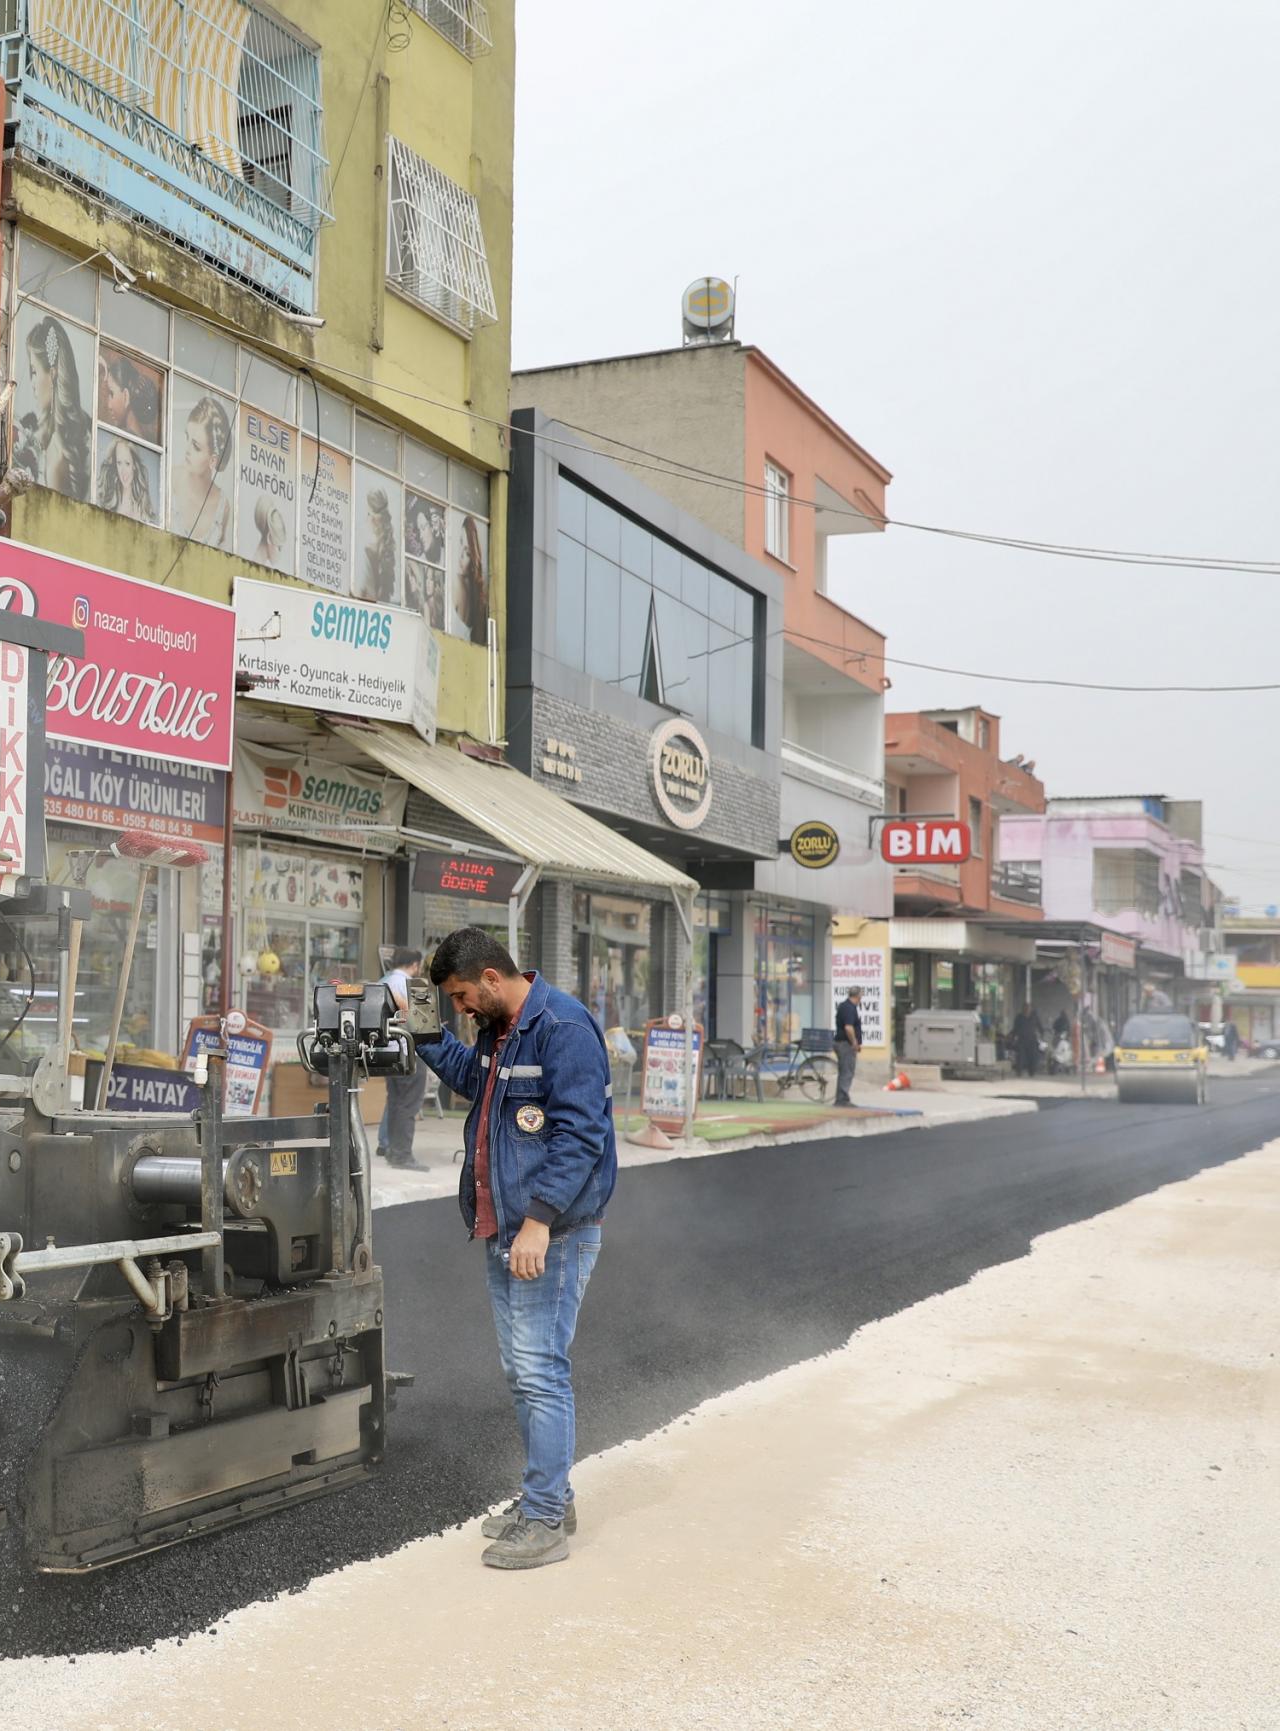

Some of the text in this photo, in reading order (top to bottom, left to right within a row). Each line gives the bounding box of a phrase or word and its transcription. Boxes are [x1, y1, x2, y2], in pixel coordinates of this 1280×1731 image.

[247, 414, 290, 453] ELSE
[250, 444, 286, 474] BAYAN
[240, 464, 294, 501] KUAFÖRÜ
[311, 600, 392, 654] sempaş
[238, 653, 290, 676] Kırtasiye
[300, 664, 349, 684] Oyuncak
[358, 675, 406, 695] Hediyelik
[348, 689, 403, 713] Züccaciye
[661, 744, 704, 786] ZORLU
[90, 768, 125, 807] KÖY
[128, 773, 207, 822] ÜRÜNLERİ
[64, 804, 84, 819] 480
[86, 806, 99, 821] 01
[102, 809, 114, 824] 66
[122, 814, 147, 828] 0505
[288, 803, 341, 825] KIRTASİYE
[797, 837, 832, 850] ZORLU
[889, 822, 962, 857] BİM
[440, 871, 488, 893] ÖDEME
[831, 951, 882, 967] EMİR
[131, 1078, 188, 1106] HATAY
